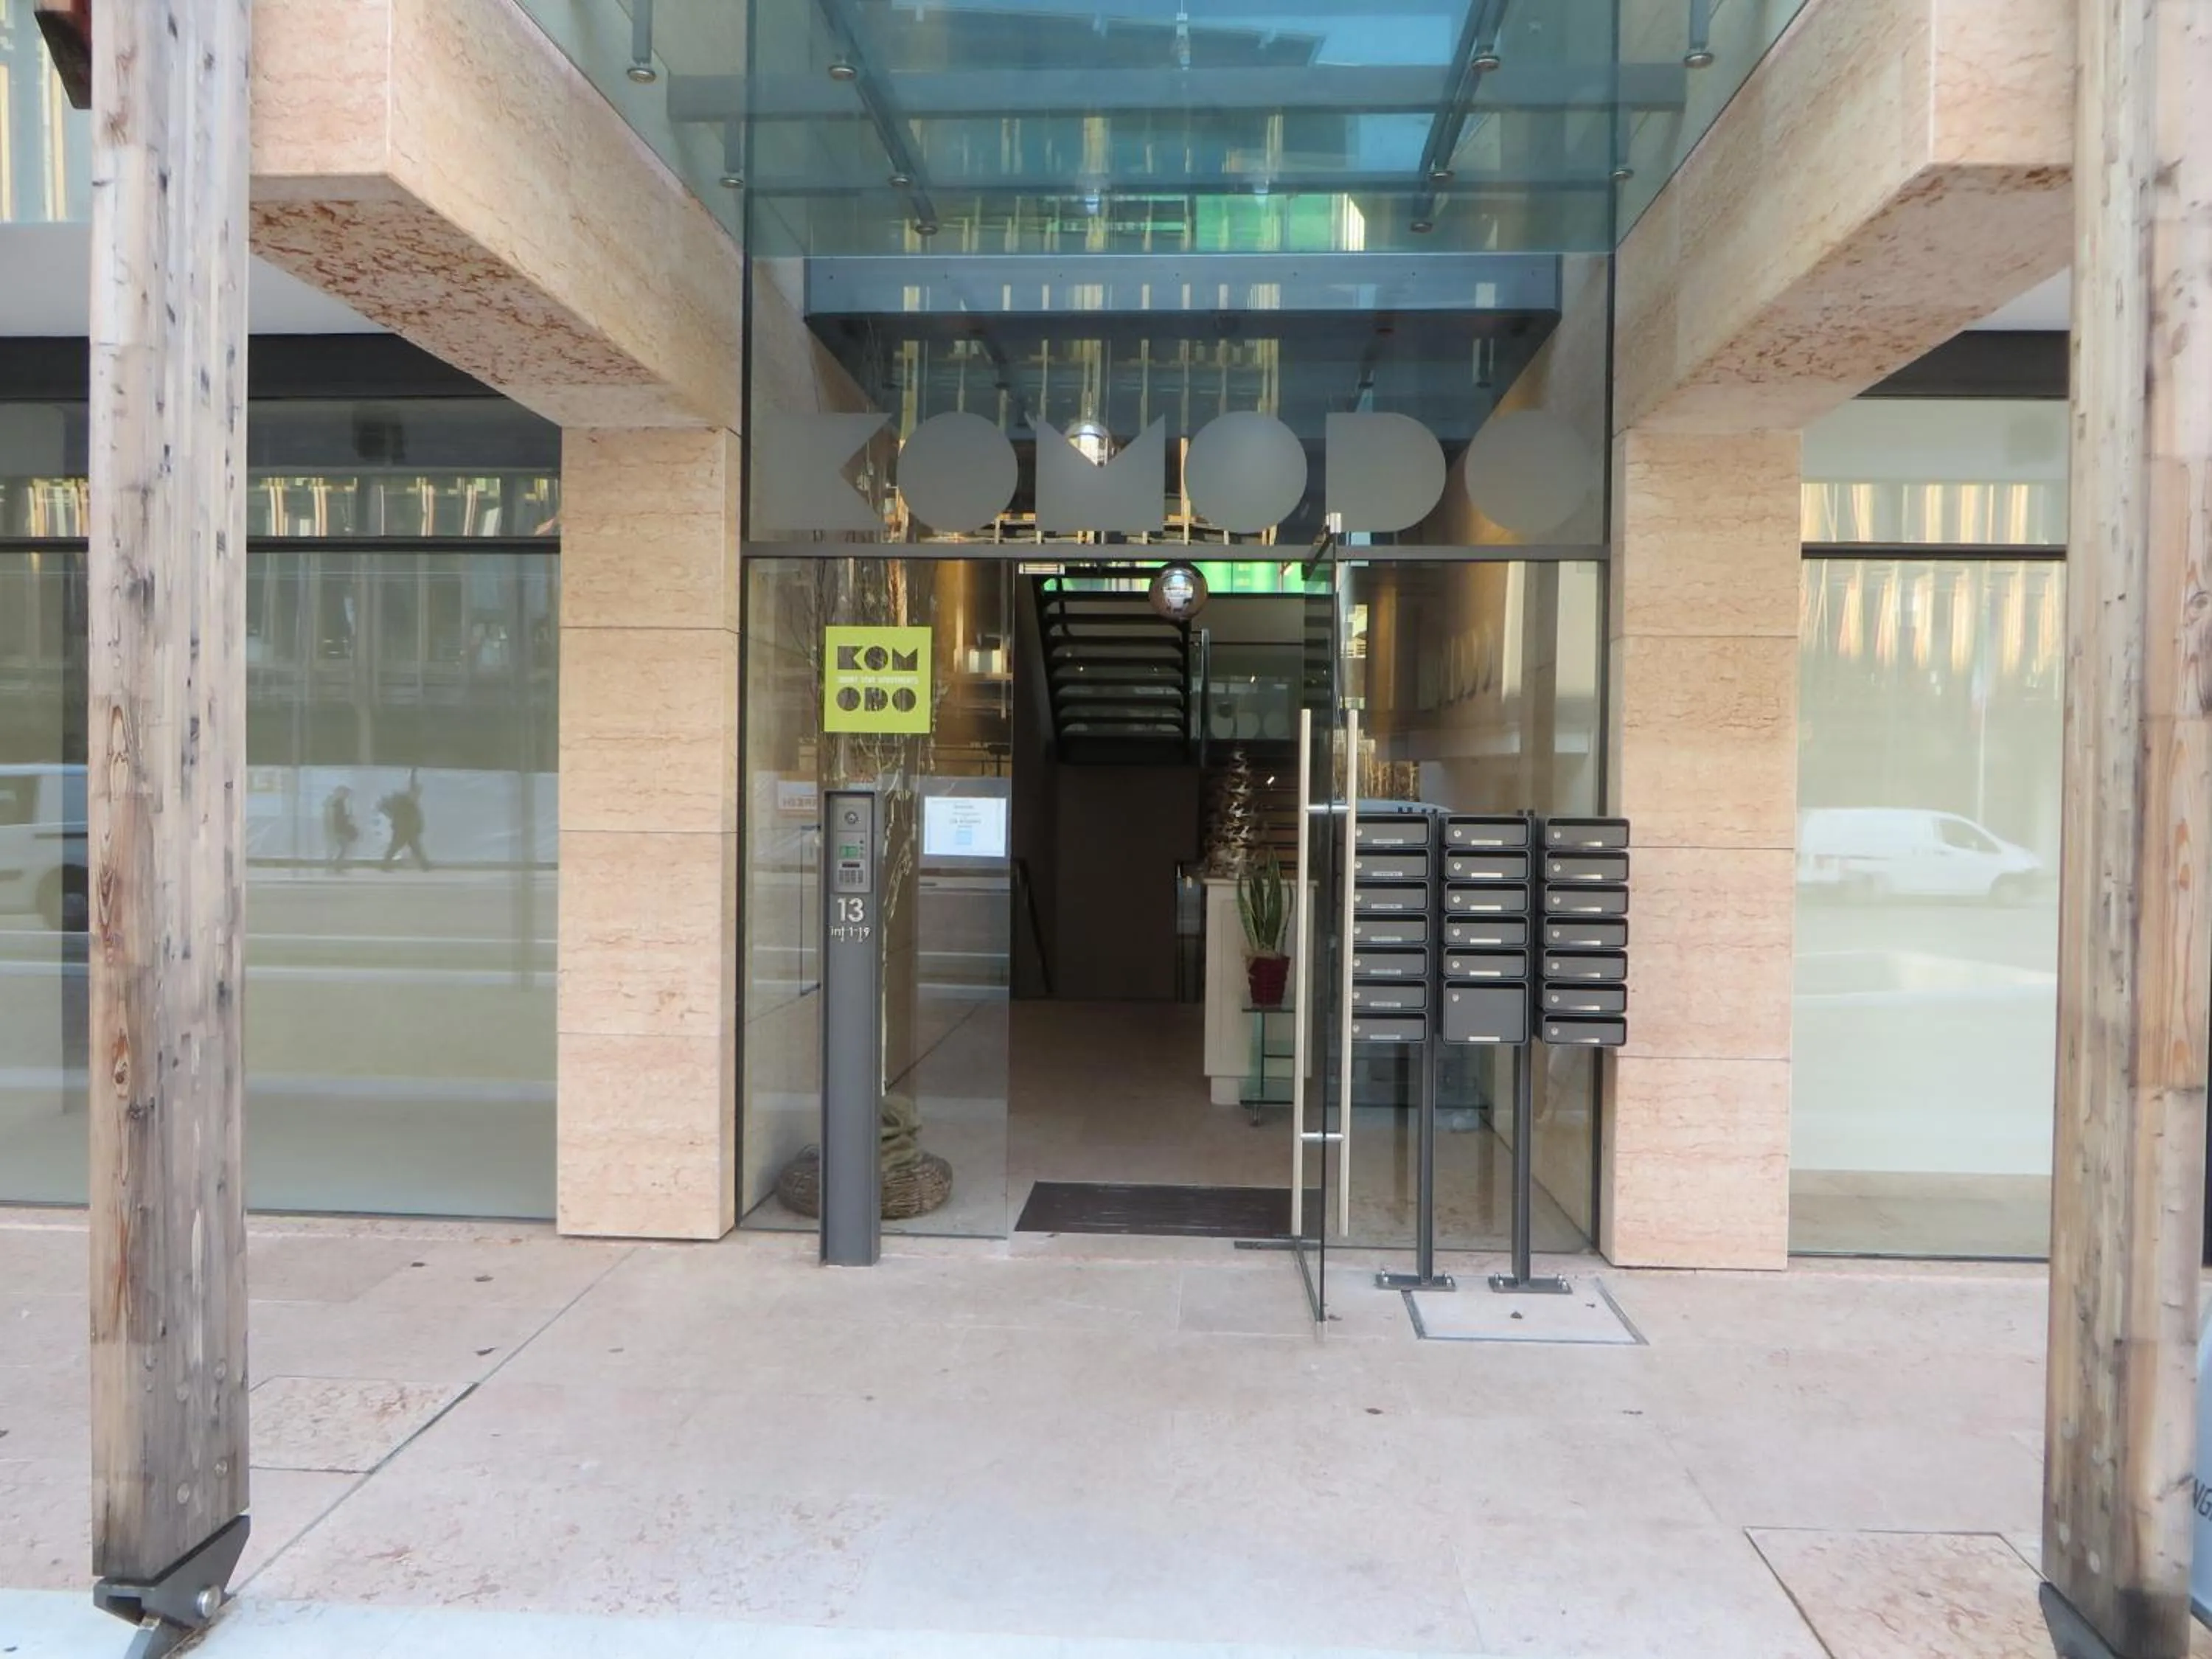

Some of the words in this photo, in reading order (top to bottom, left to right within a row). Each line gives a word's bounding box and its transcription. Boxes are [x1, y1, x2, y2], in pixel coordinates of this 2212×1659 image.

[768, 410, 1591, 534] KOMODO
[837, 645, 919, 671] KOM
[836, 686, 917, 712] ODO
[837, 897, 864, 922] 13
